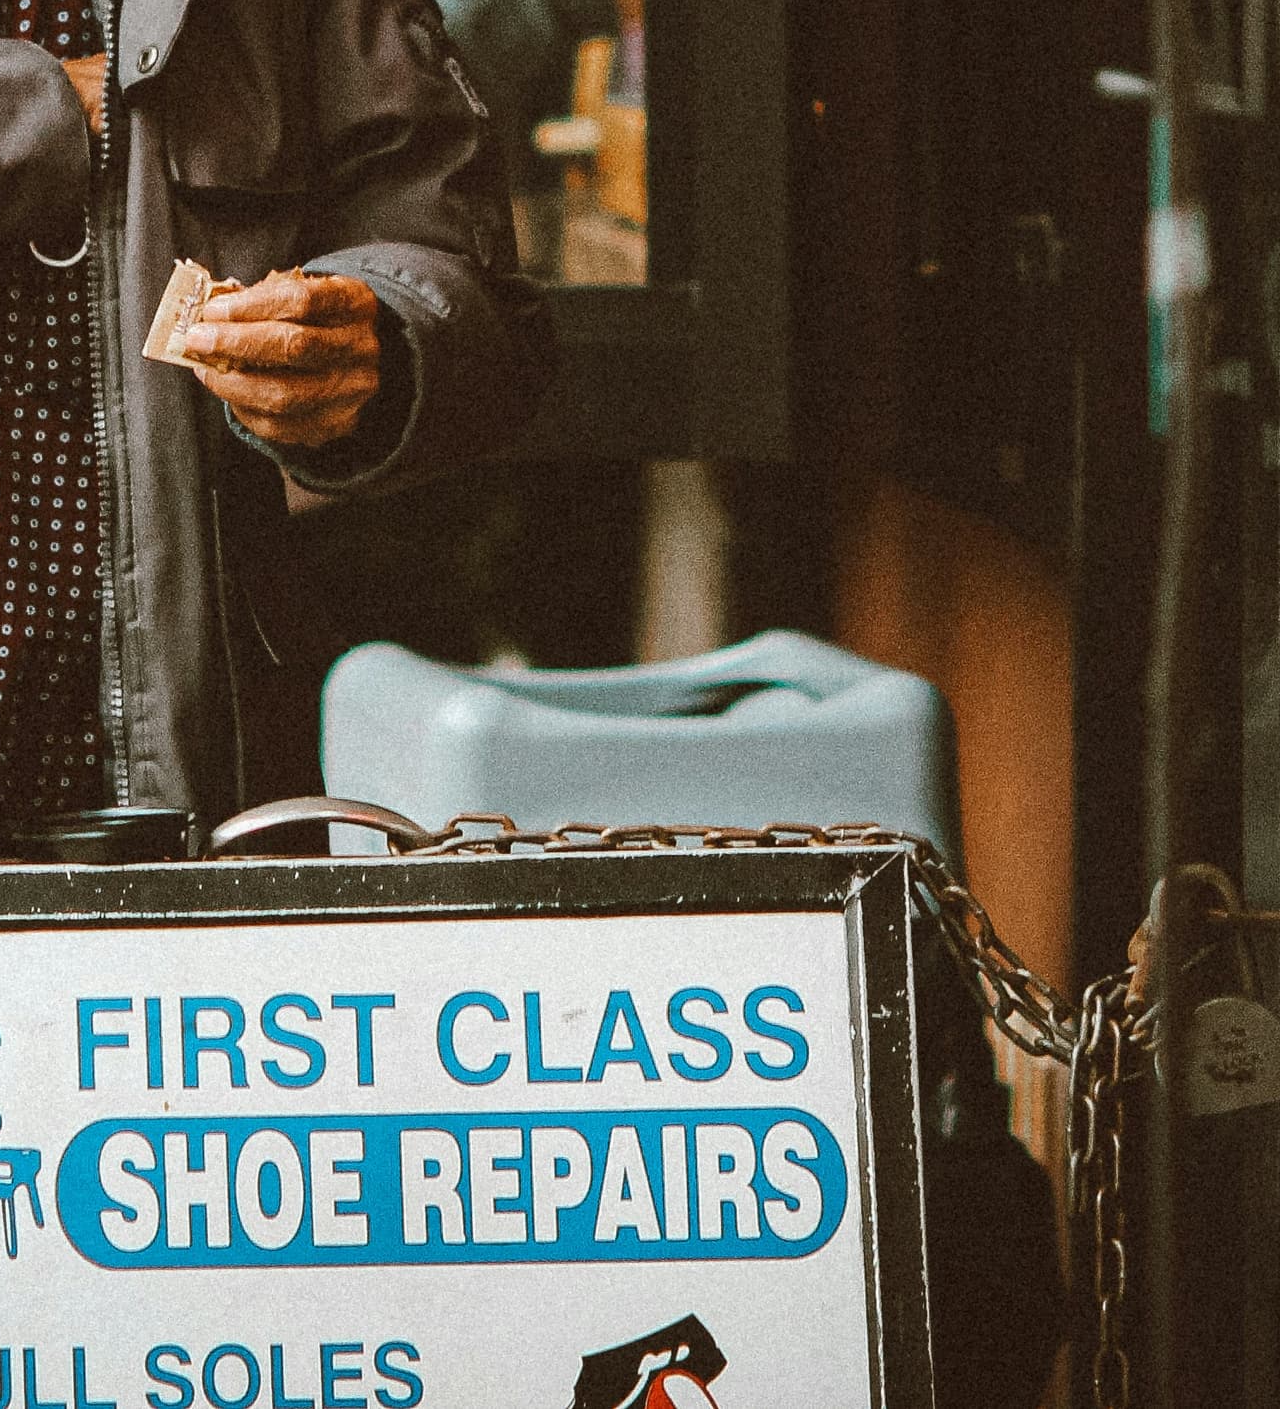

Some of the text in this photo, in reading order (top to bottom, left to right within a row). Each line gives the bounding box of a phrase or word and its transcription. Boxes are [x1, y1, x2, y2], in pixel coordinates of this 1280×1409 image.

[77, 984, 811, 1089] FIRST CLASS
[97, 1119, 824, 1252] SHOE REPAIRS
[145, 1339, 424, 1409] SOLES
